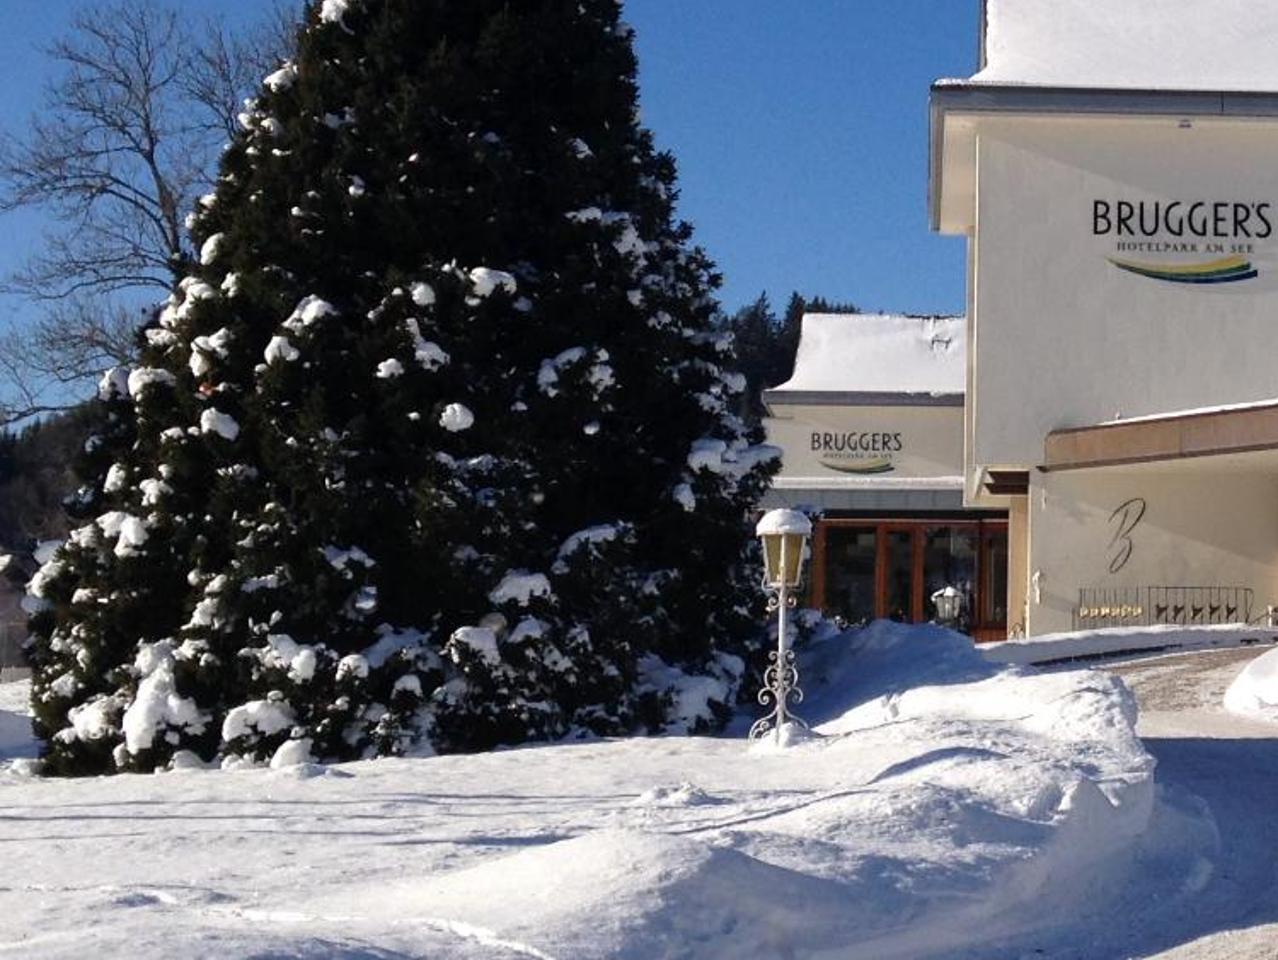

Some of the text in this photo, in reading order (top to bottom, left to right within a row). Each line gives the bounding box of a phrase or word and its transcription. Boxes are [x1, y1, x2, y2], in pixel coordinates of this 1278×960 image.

[1117, 242, 1254, 254] HOTELPARK AM SEE
